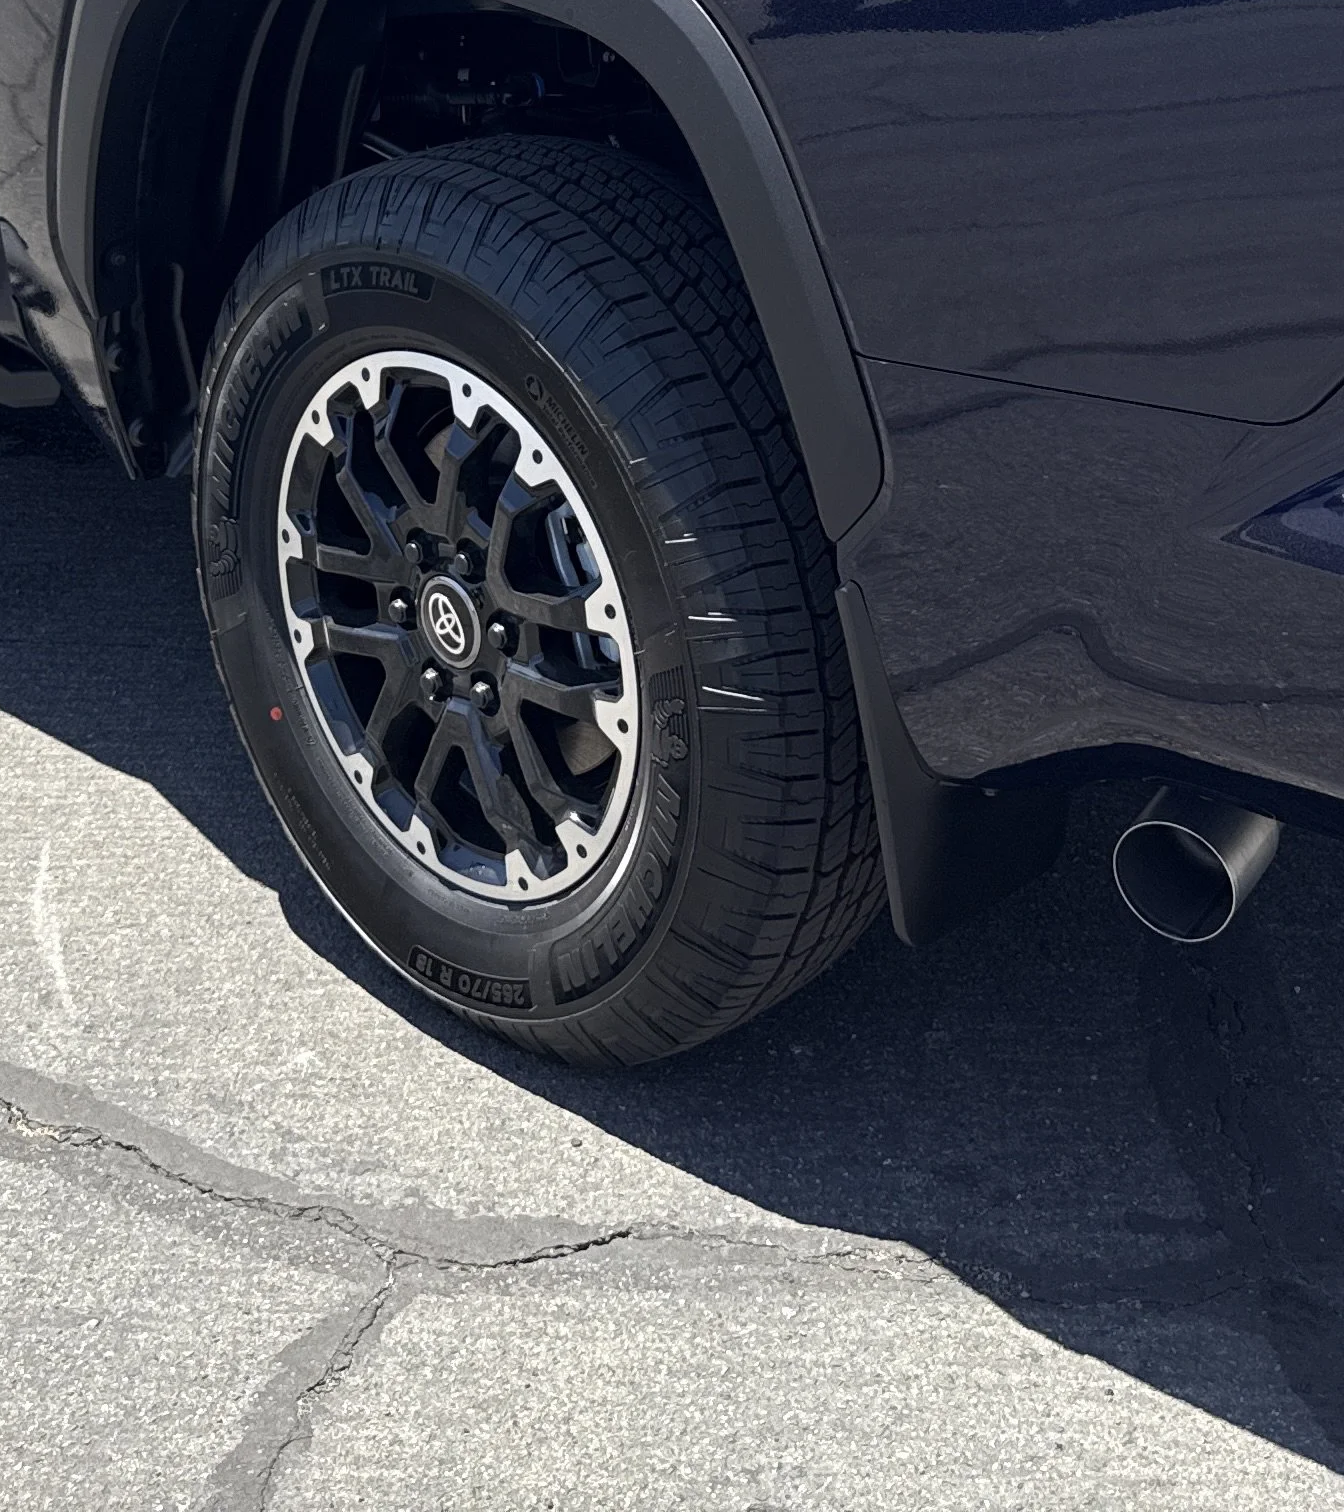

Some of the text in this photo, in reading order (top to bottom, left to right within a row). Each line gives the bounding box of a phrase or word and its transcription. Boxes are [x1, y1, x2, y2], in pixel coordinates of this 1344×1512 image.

[330, 266, 419, 294] LTX TRAIL
[211, 296, 304, 512] MICHELIN
[546, 396, 589, 456] MICHELIN
[557, 774, 681, 992] MICHELIN
[440, 966, 453, 988] R
[458, 974, 525, 1005] 265/70
